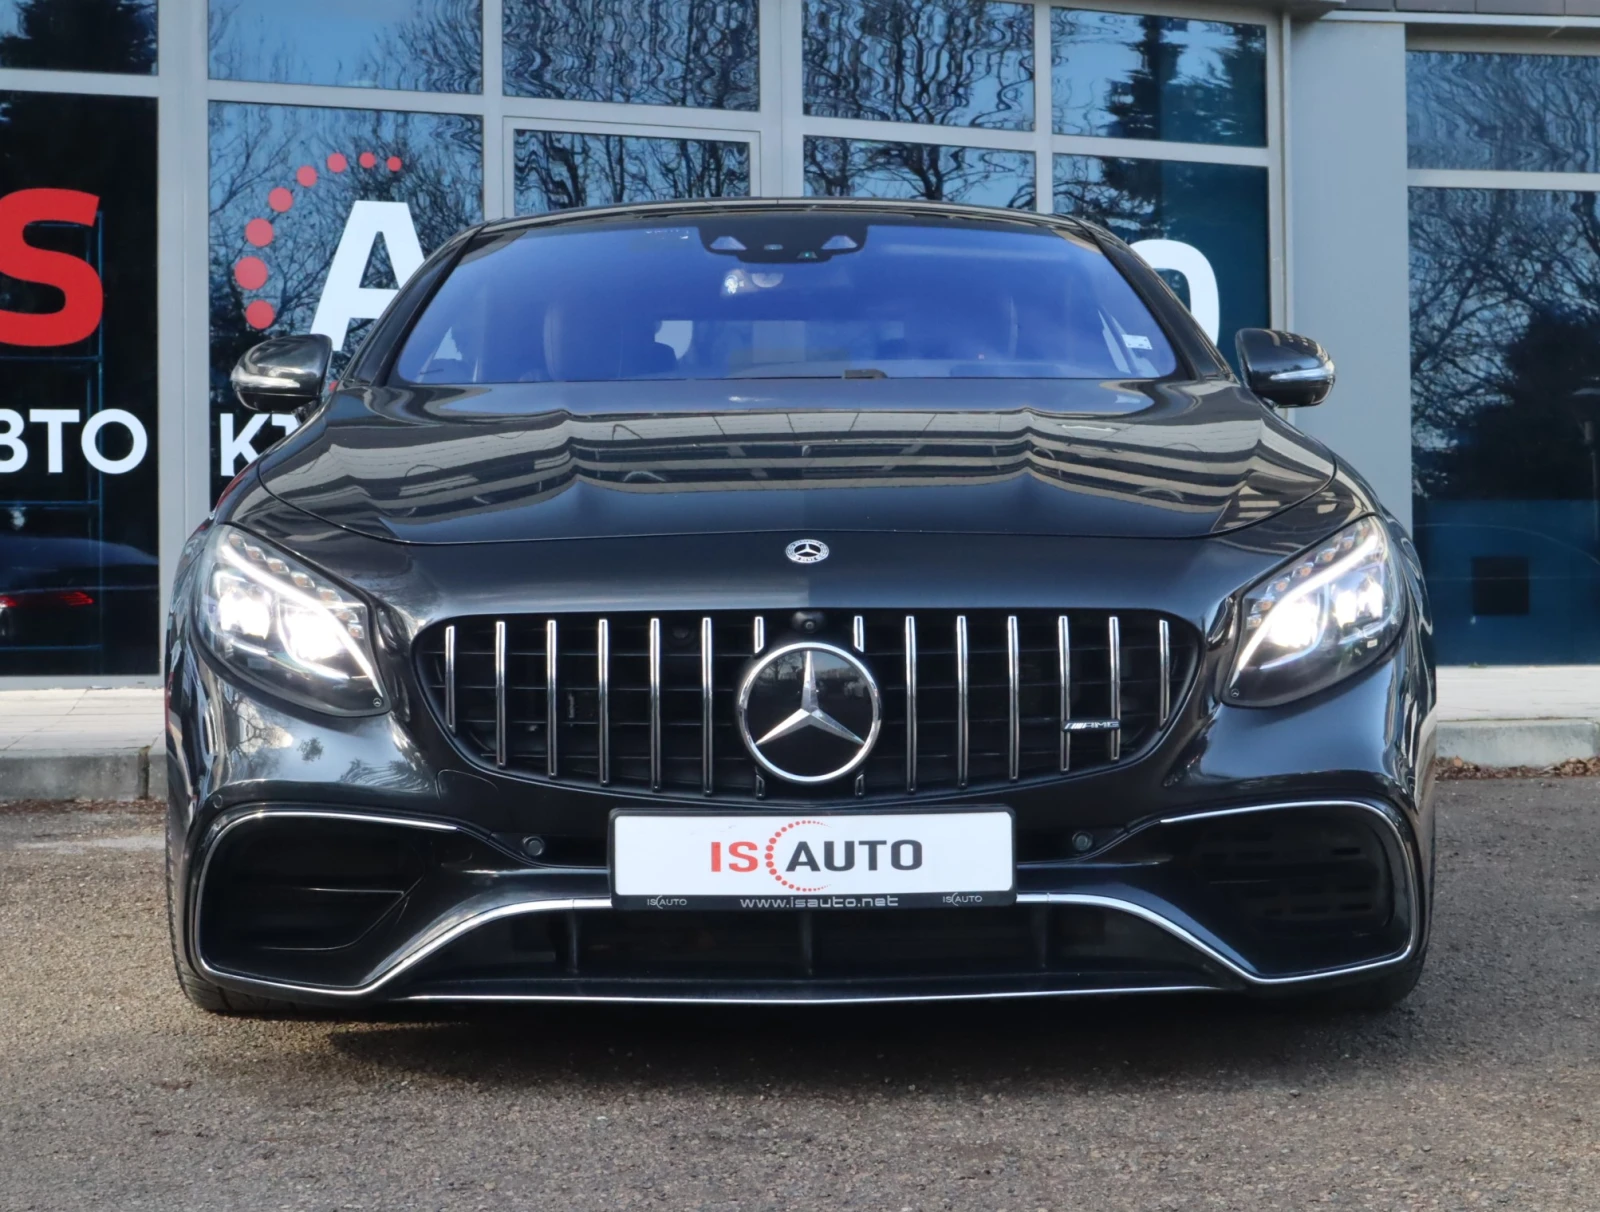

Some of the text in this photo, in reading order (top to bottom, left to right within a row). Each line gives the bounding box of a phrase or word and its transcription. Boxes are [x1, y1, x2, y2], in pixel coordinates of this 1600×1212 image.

[710, 839, 923, 873] IS AUTO
[739, 895, 899, 909] www.isauto.net
